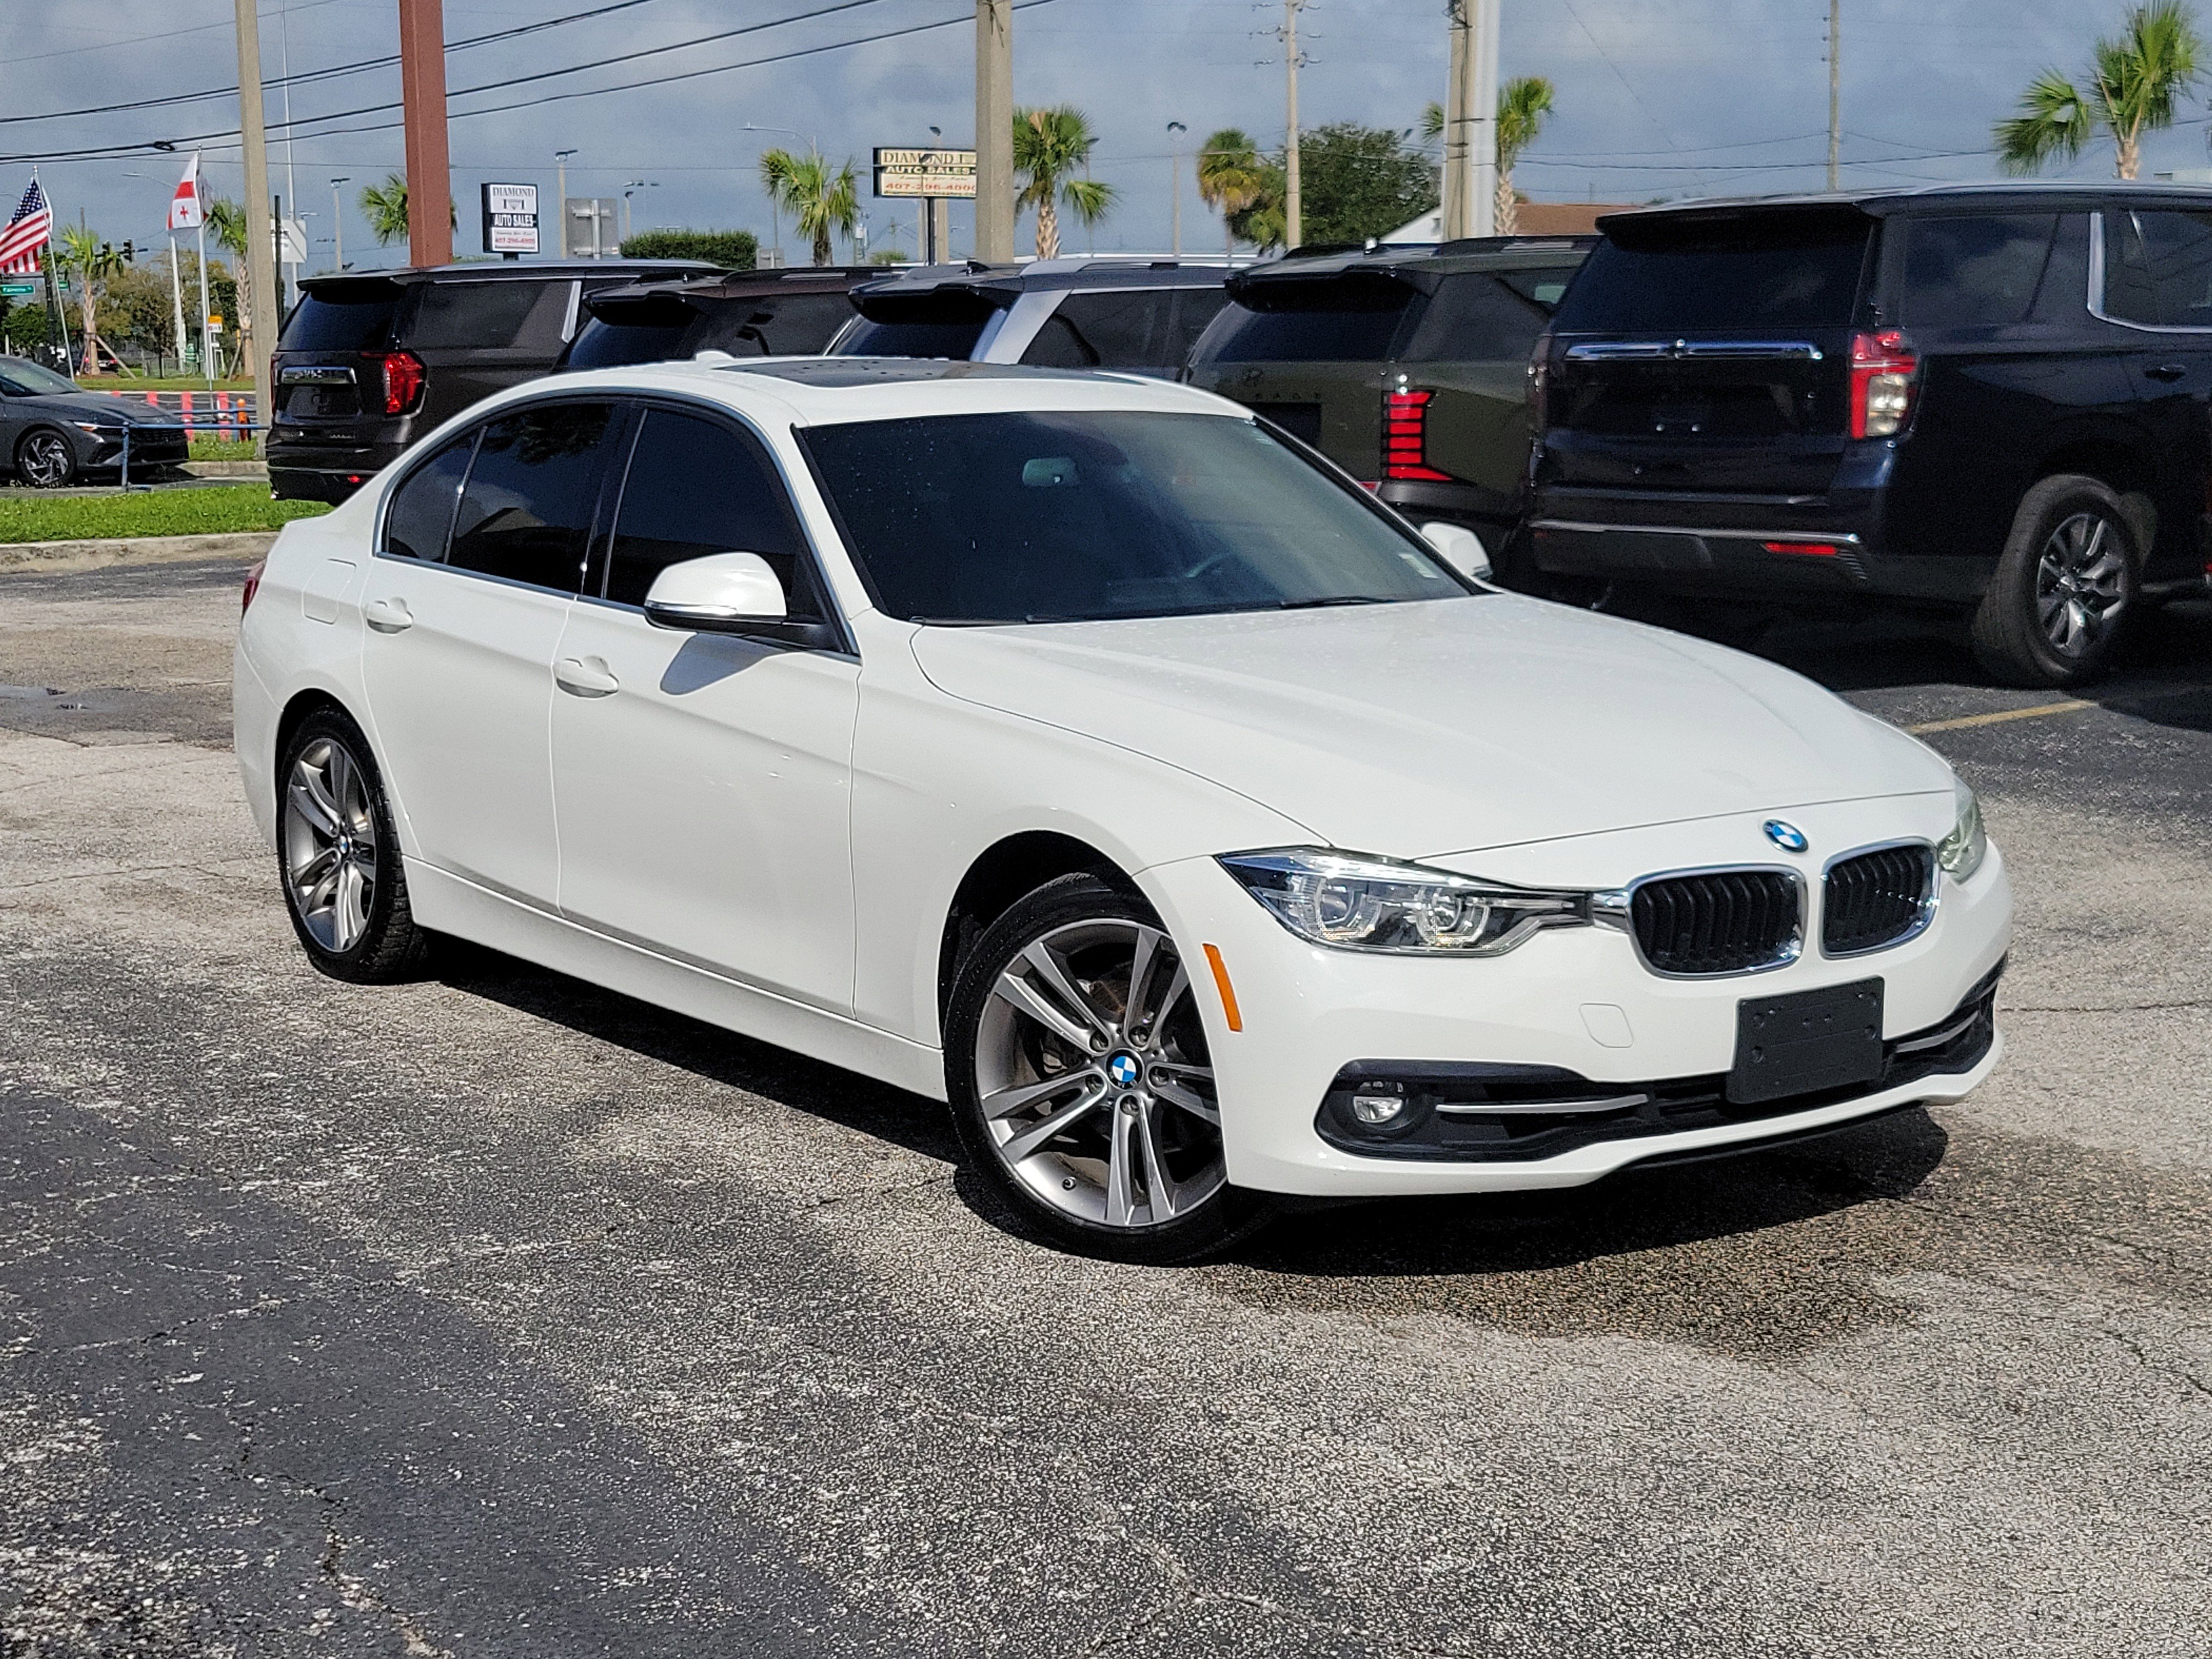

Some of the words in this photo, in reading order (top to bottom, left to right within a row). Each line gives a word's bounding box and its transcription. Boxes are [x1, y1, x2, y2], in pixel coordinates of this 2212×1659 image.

[885, 166, 923, 174] AUTO
[493, 187, 534, 197] DIAMOND
[494, 214, 511, 226] AUTO
